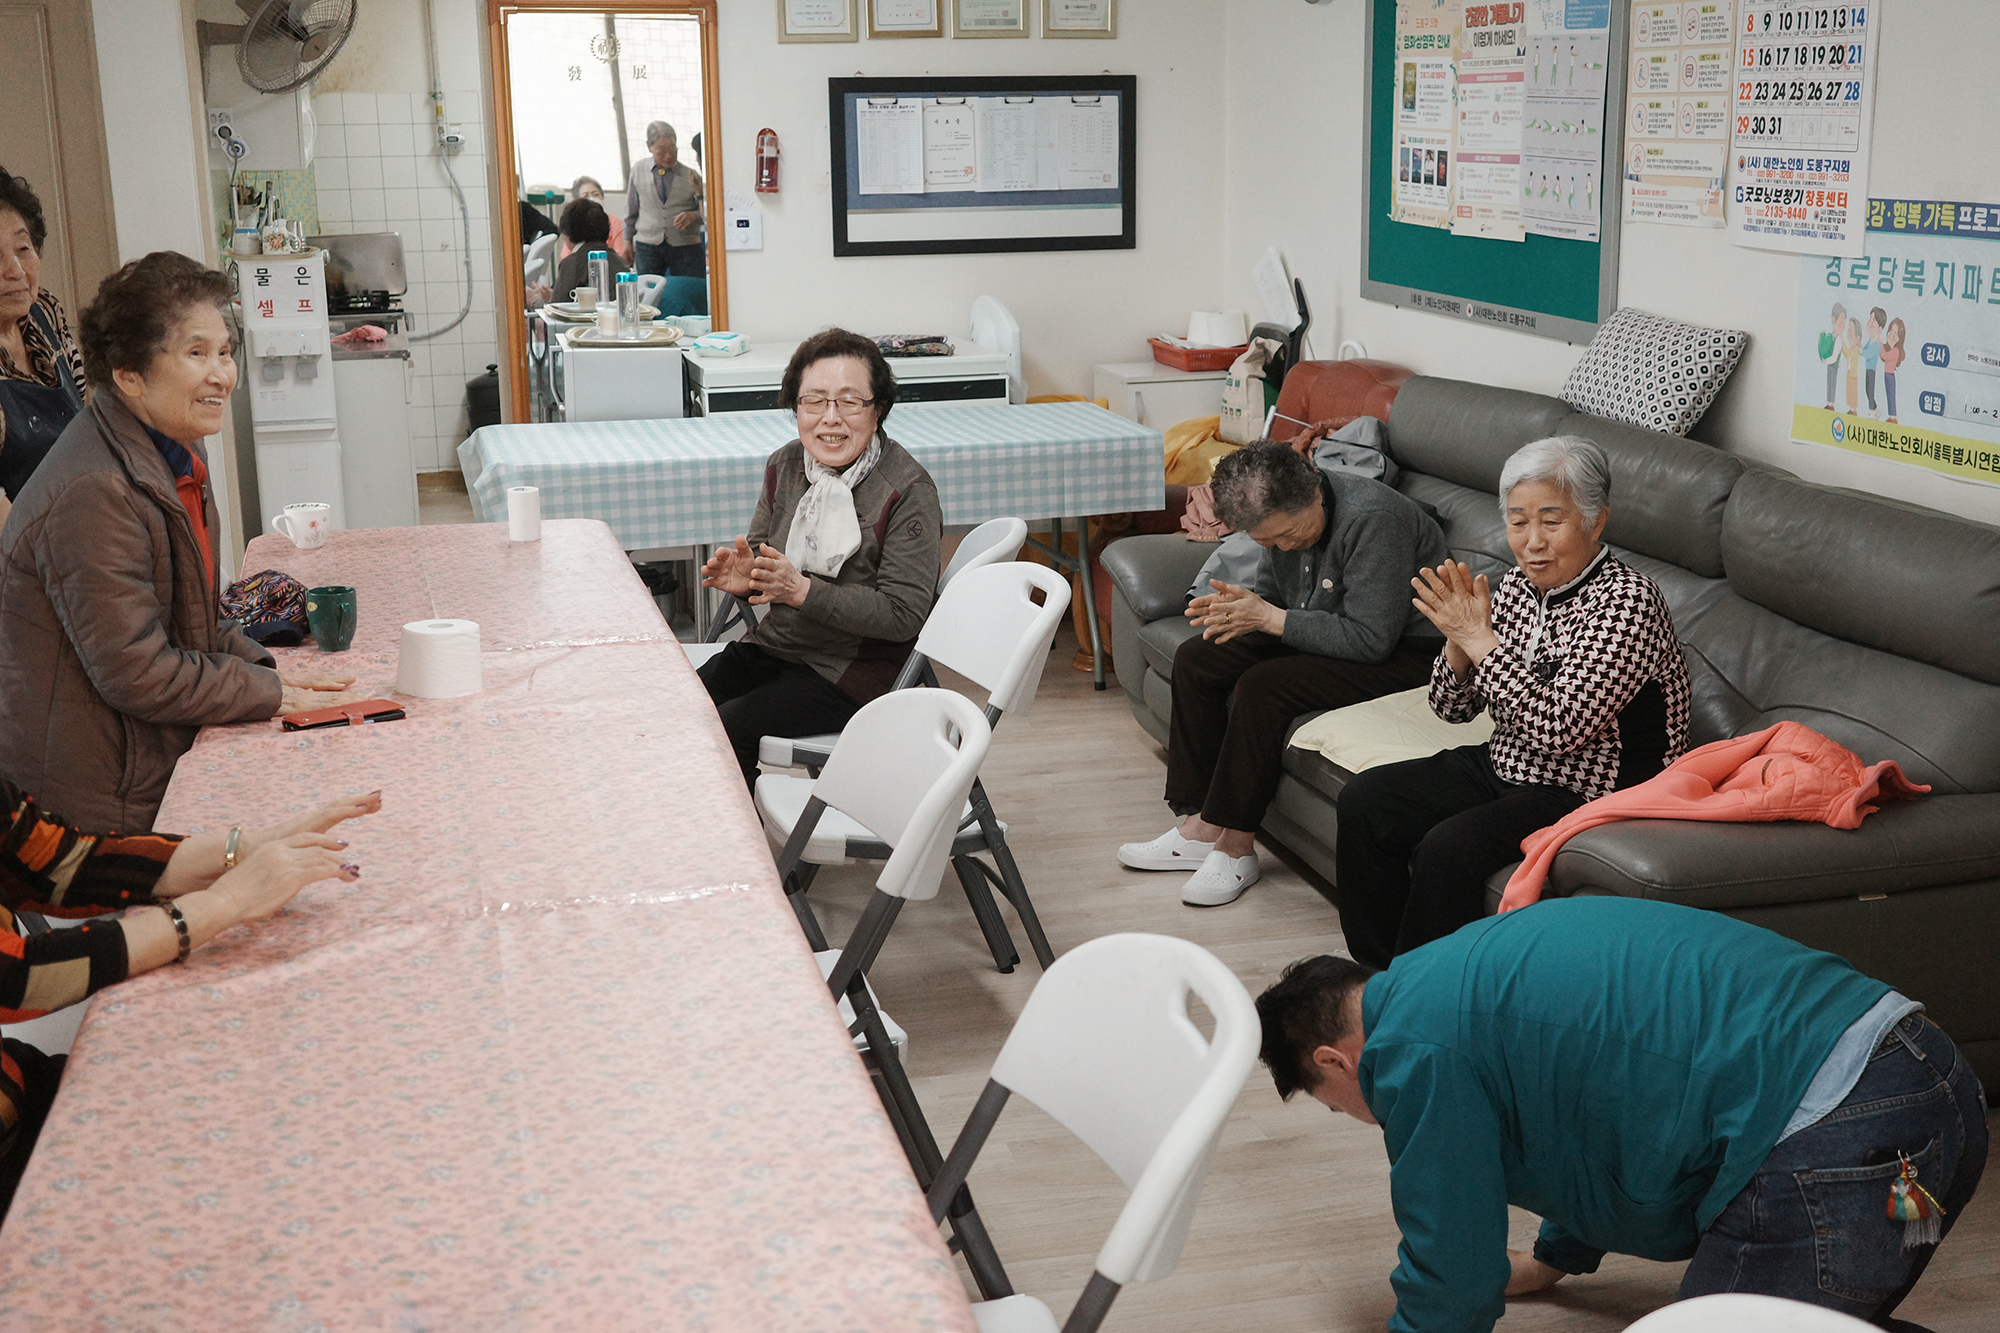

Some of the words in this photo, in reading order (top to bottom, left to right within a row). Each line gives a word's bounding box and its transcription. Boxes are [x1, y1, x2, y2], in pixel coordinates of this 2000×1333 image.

[1465, 5, 1488, 28] 건강한
[1490, 1, 1525, 26] 겨울나기
[1746, 14, 1754, 32] 8
[1764, 13, 1772, 31] 9
[1779, 12, 1792, 30] 10
[1797, 11, 1809, 30] 11
[1815, 10, 1828, 28] 12
[1832, 9, 1846, 28] 13
[1851, 8, 1865, 26] 14
[1437, 34, 1451, 49] 안내
[1474, 30, 1493, 48] 이렇게
[1494, 29, 1516, 46] 하세요!
[1742, 48, 1754, 66] 15
[1759, 48, 1772, 66] 16
[1776, 48, 1790, 66] 17
[1794, 46, 1808, 65] 18
[1812, 46, 1826, 65] 19
[1829, 45, 1844, 65] 20
[1848, 45, 1862, 64] 21
[632, 64, 647, 80] 展
[1739, 82, 1752, 100] 22
[1754, 82, 1769, 100] 23
[1772, 82, 1786, 100] 24
[1789, 82, 1804, 100] 25
[1807, 82, 1822, 100] 26
[1826, 82, 1842, 100] 27
[1844, 81, 1860, 100] 28
[1737, 116, 1749, 134] 29
[1752, 116, 1765, 134] 30
[1769, 116, 1782, 134] 31
[1747, 156, 1760, 168] (사)
[1763, 157, 1804, 171] 대한노인회
[1806, 158, 1850, 173] 도봉구지회
[1745, 186, 1804, 205] 굿모닝보청기
[1806, 190, 1848, 209] 창동센터
[1924, 204, 1955, 232] 가득
[1509, 313, 1536, 329] 도봉구지회
[1926, 347, 1946, 363] 감사
[1924, 395, 1942, 413] 일정
